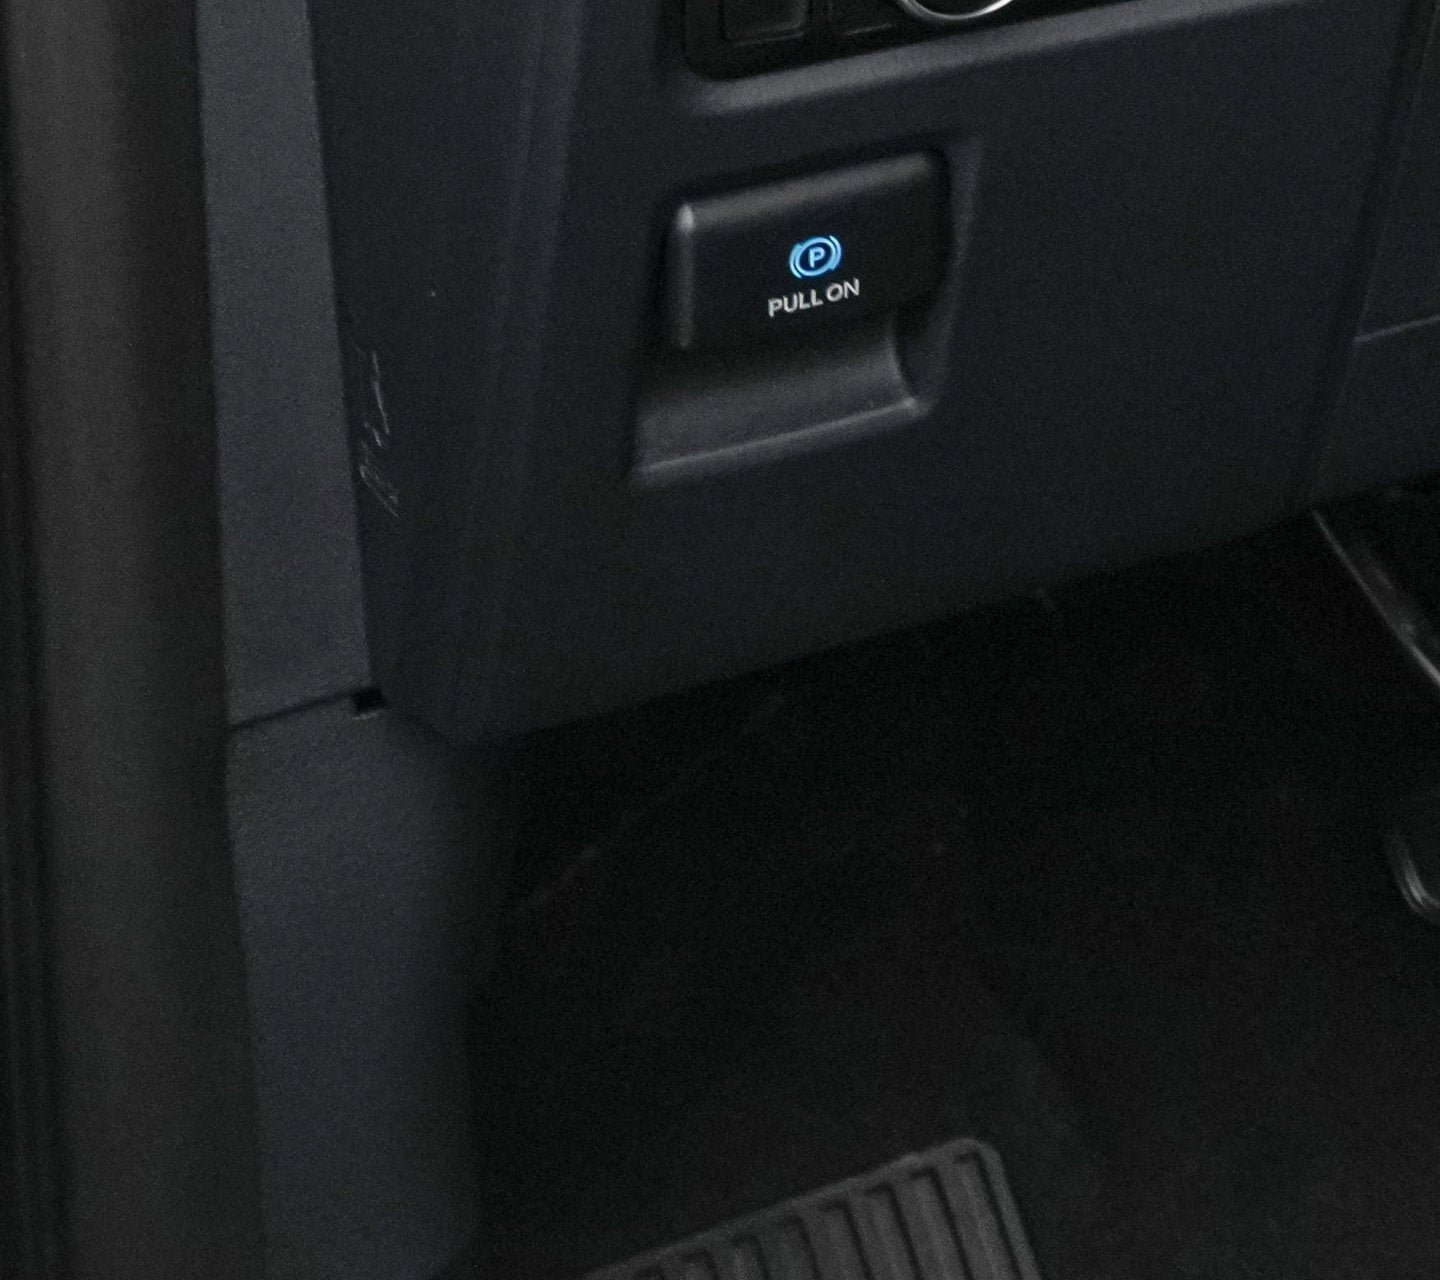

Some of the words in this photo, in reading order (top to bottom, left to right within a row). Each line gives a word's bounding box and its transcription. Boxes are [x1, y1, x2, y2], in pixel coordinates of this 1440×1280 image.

[808, 246, 827, 269] P
[767, 288, 824, 319] PULL
[825, 277, 861, 304] ON
